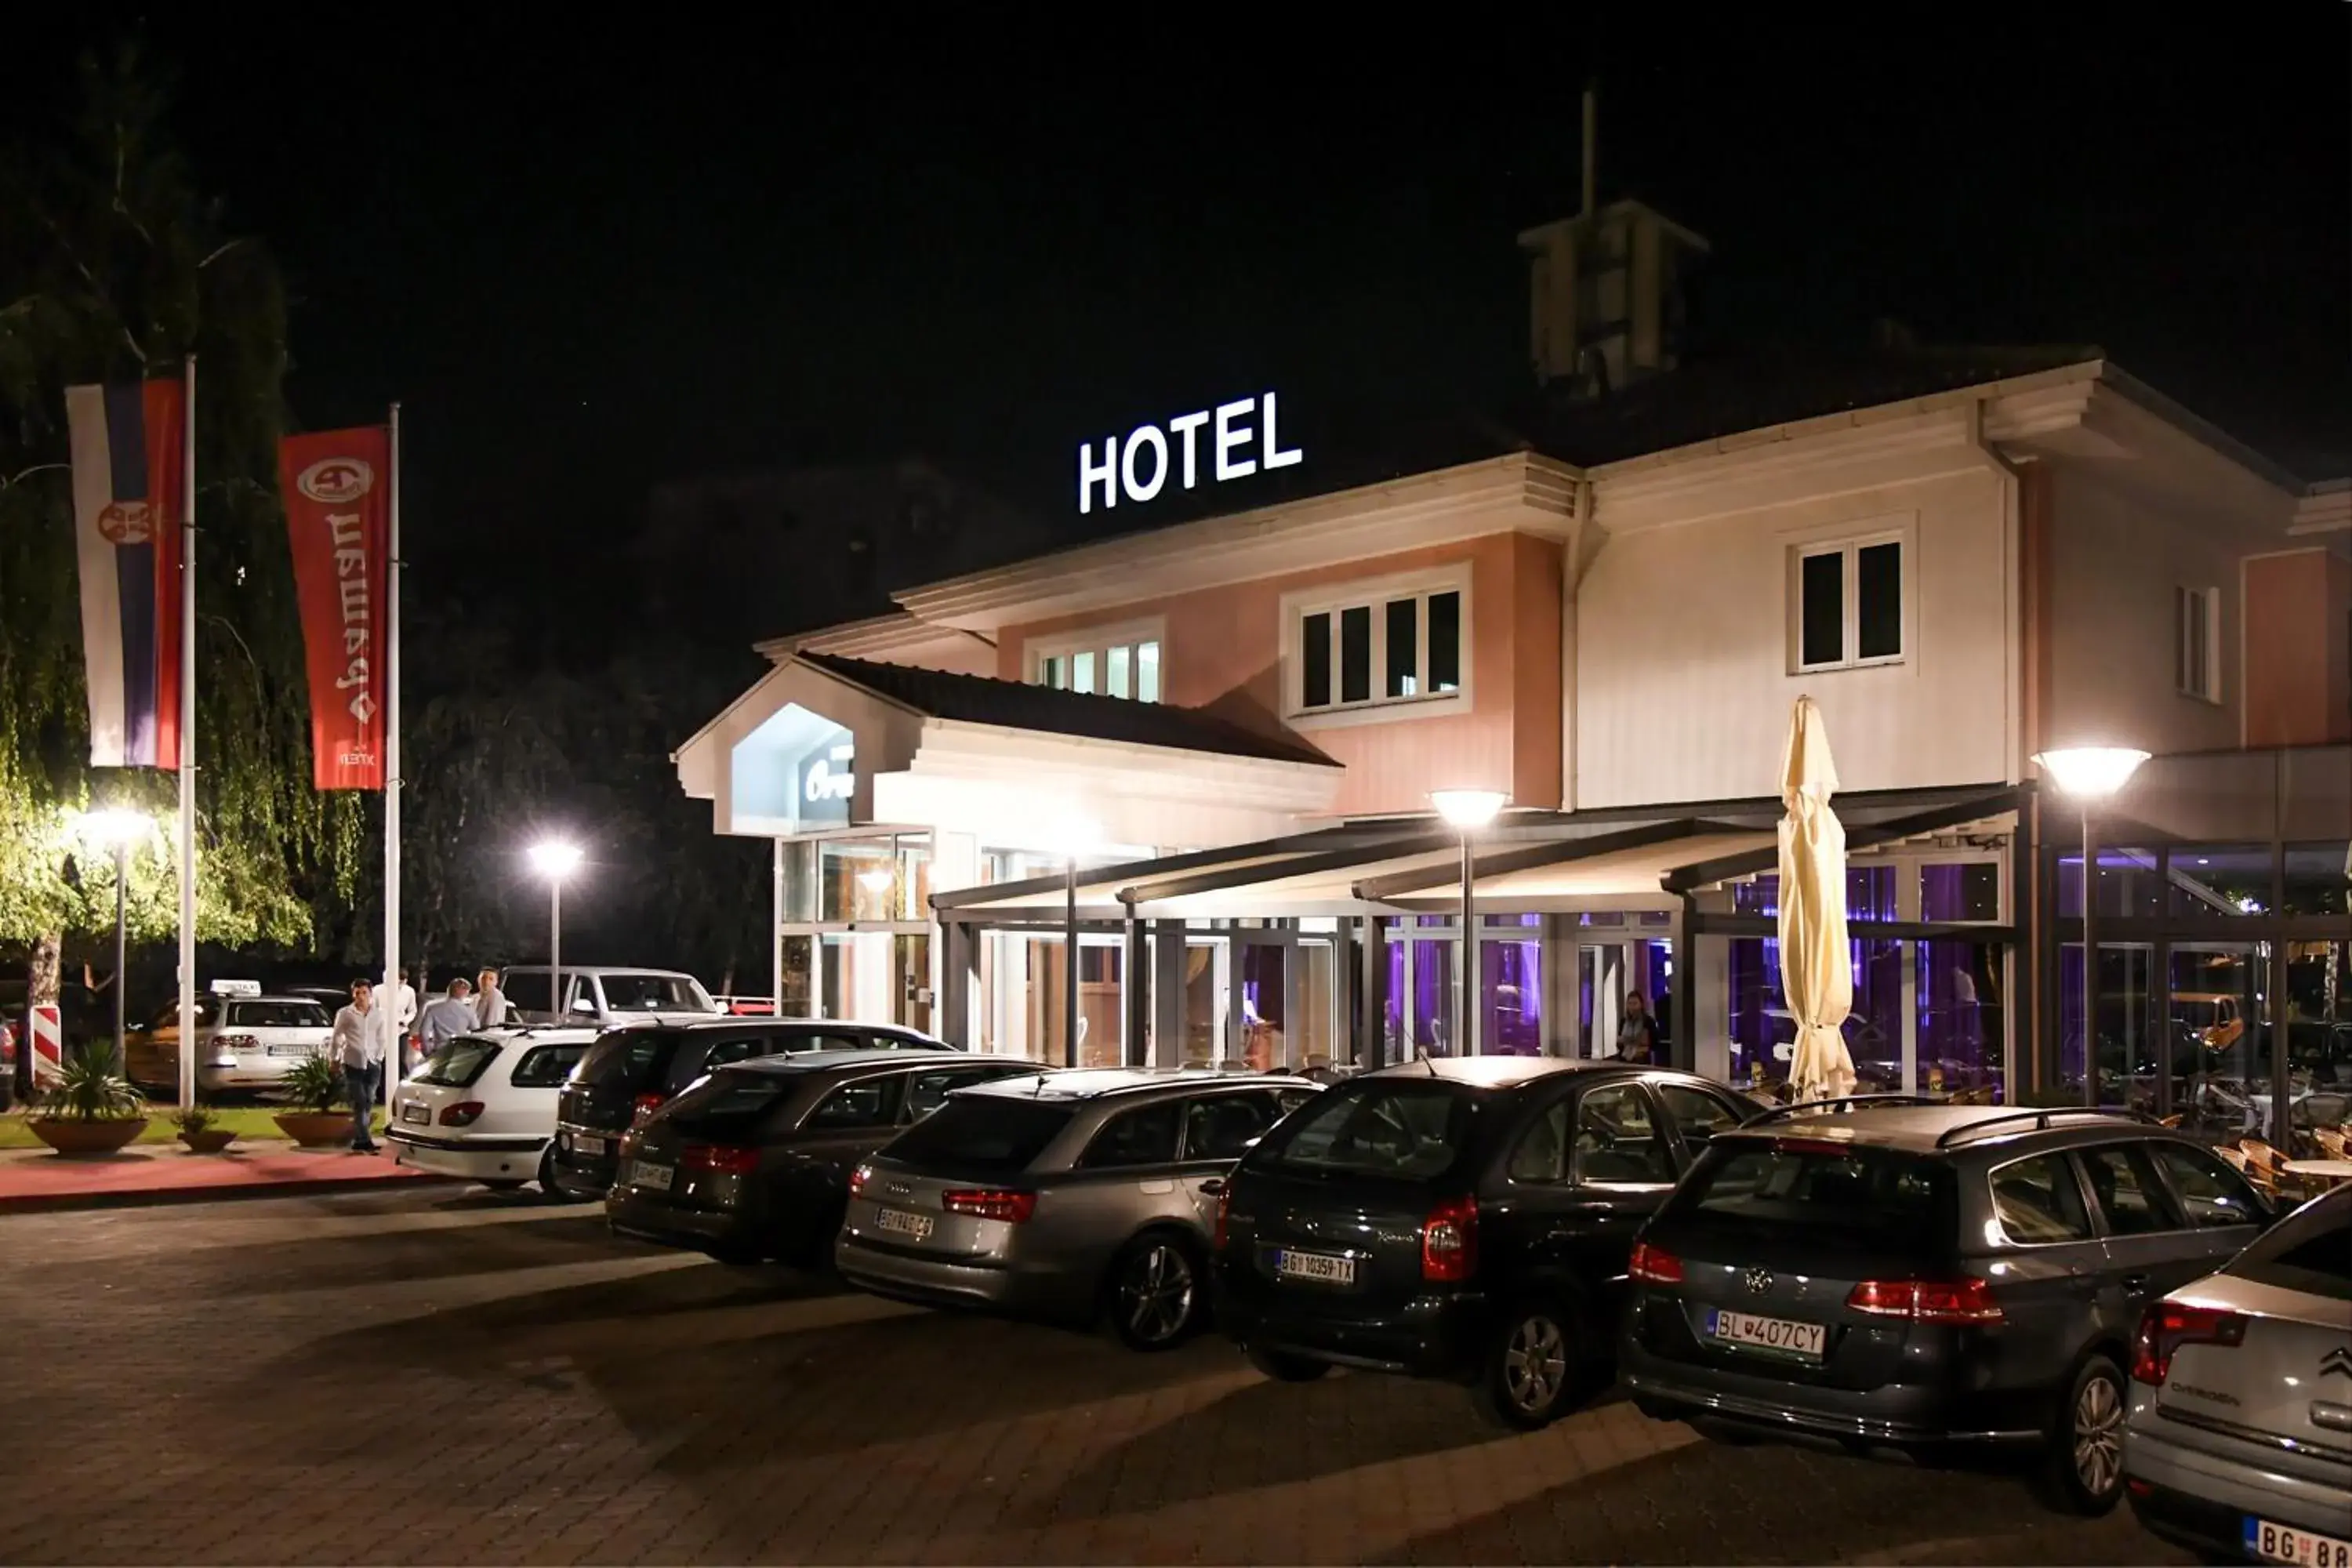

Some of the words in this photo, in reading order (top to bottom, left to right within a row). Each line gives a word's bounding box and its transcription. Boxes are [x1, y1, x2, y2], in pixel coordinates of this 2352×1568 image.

[1080, 392, 1302, 514] HOTEL
[1282, 1253, 1297, 1271] BG
[1719, 1313, 1741, 1338] BL
[1754, 1319, 1820, 1351] 407CY
[2263, 1526, 2294, 1558] BG
